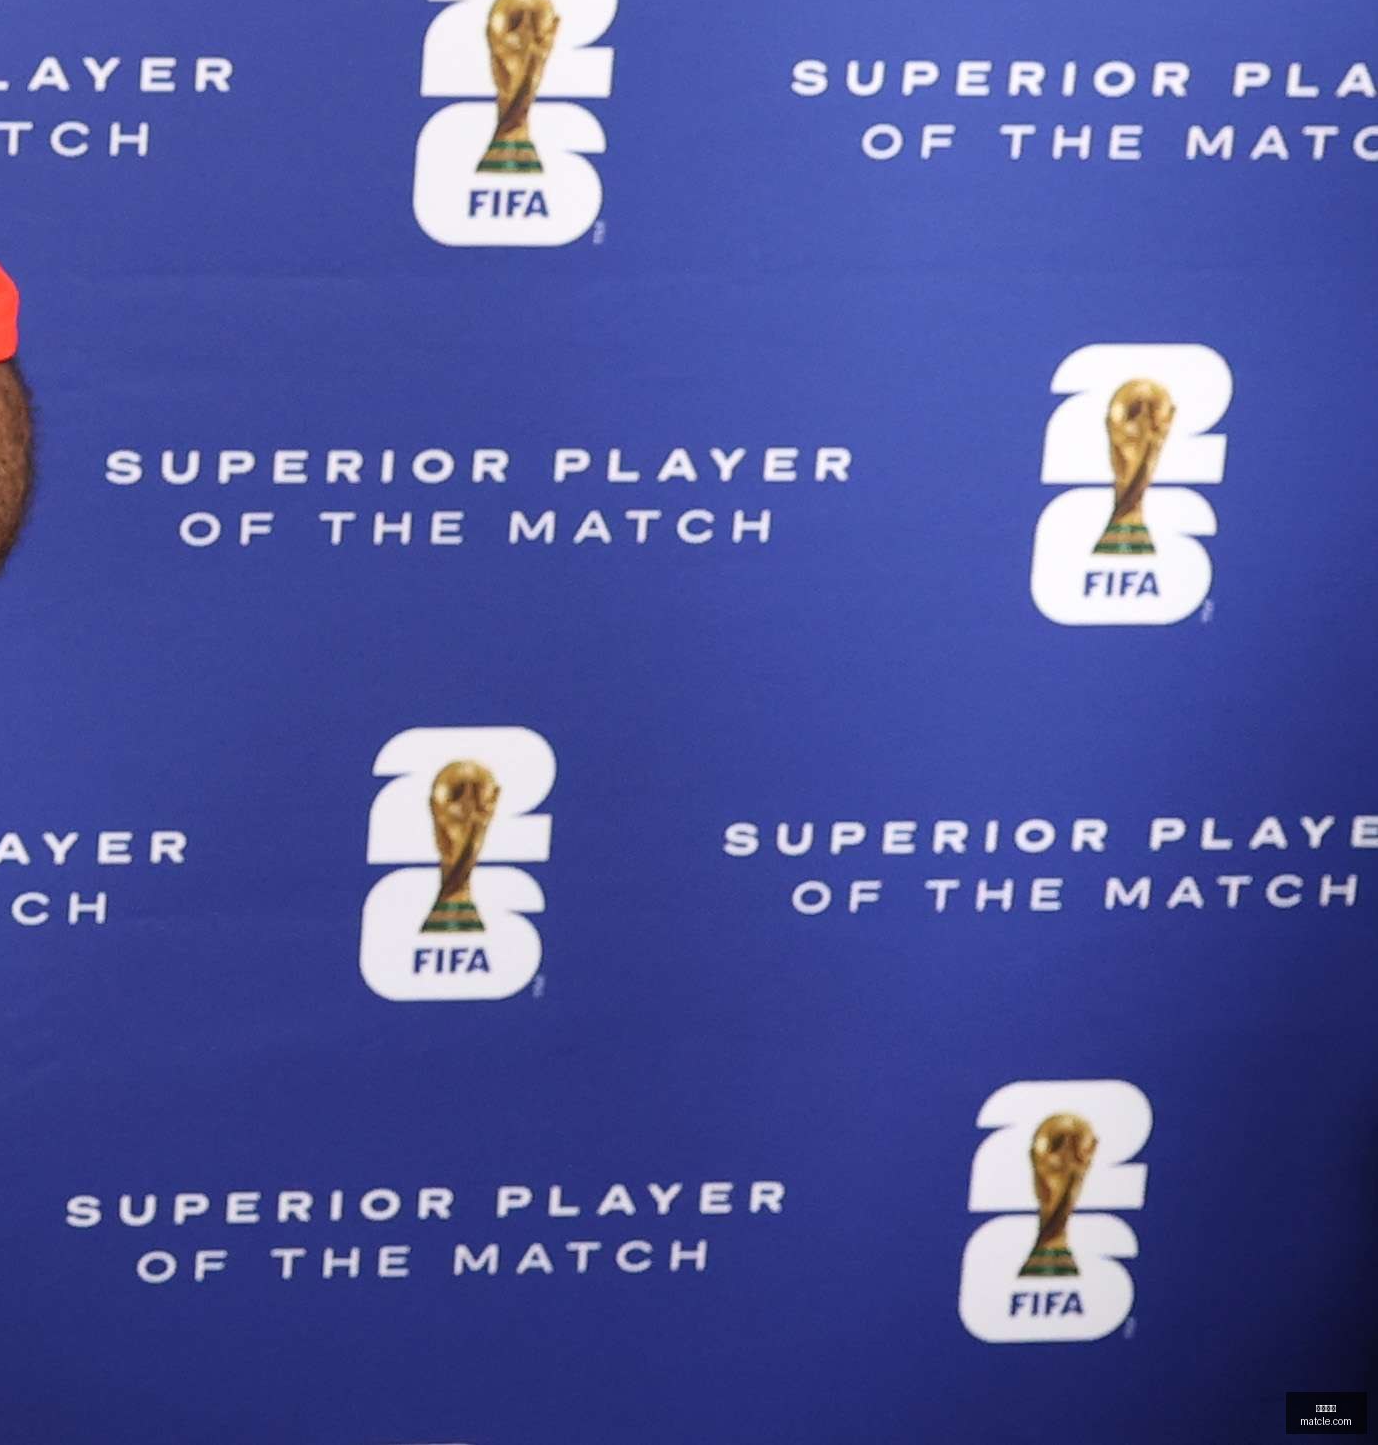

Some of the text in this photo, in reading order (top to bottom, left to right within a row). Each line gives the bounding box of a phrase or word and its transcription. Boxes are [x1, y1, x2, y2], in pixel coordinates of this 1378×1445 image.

[791, 60, 1376, 97] SUPERIOR PLA
[862, 124, 1378, 161] OF THE MATC
[468, 191, 548, 217] FIFA
[105, 447, 852, 485] SUPERIOR PLAYER
[180, 509, 771, 547] OF THE MATCH
[1084, 572, 1159, 596] FIFA
[723, 815, 1378, 856] SUPERIOR PLAYE
[792, 874, 1357, 915] OF THE MATCH
[413, 948, 489, 973] FIFA
[66, 1181, 785, 1228] SUPERIOR PLAYER
[137, 1239, 707, 1283] OF THE MATCH
[1009, 1292, 1084, 1316] FIFA
